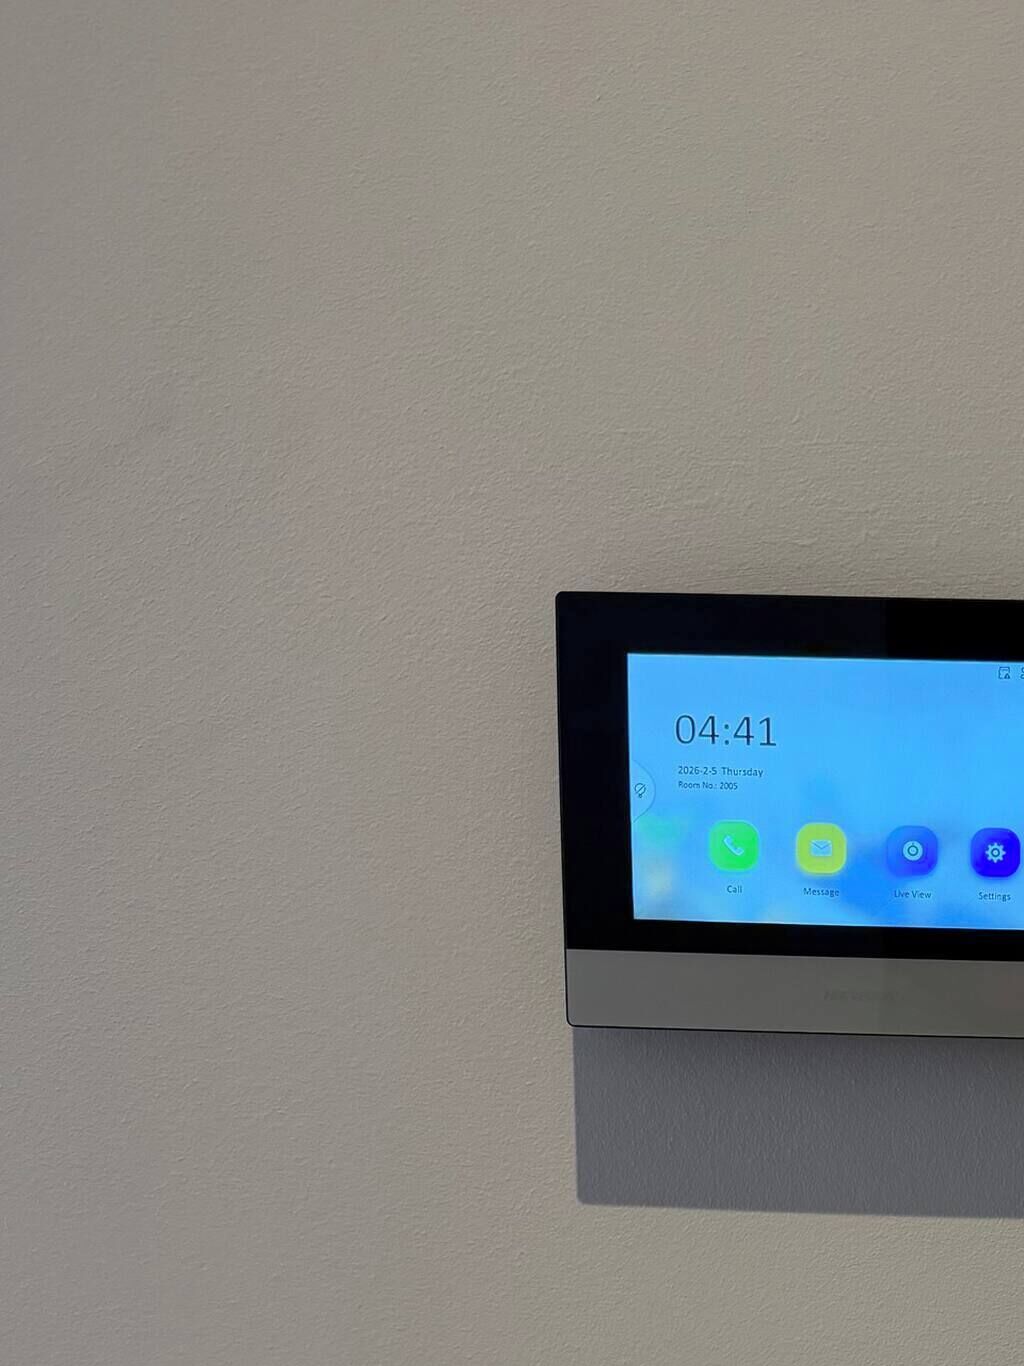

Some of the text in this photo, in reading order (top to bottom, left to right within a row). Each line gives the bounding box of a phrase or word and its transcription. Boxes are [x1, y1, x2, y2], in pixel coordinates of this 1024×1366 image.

[675, 714, 777, 746] 04:41
[678, 766, 764, 778] 2026-2-5 Thursday
[678, 781, 701, 790] Room
[720, 782, 738, 791] 2005
[726, 885, 743, 894] Call
[803, 887, 840, 898] Message
[894, 889, 932, 899] Live View
[978, 892, 1011, 902] Settings
